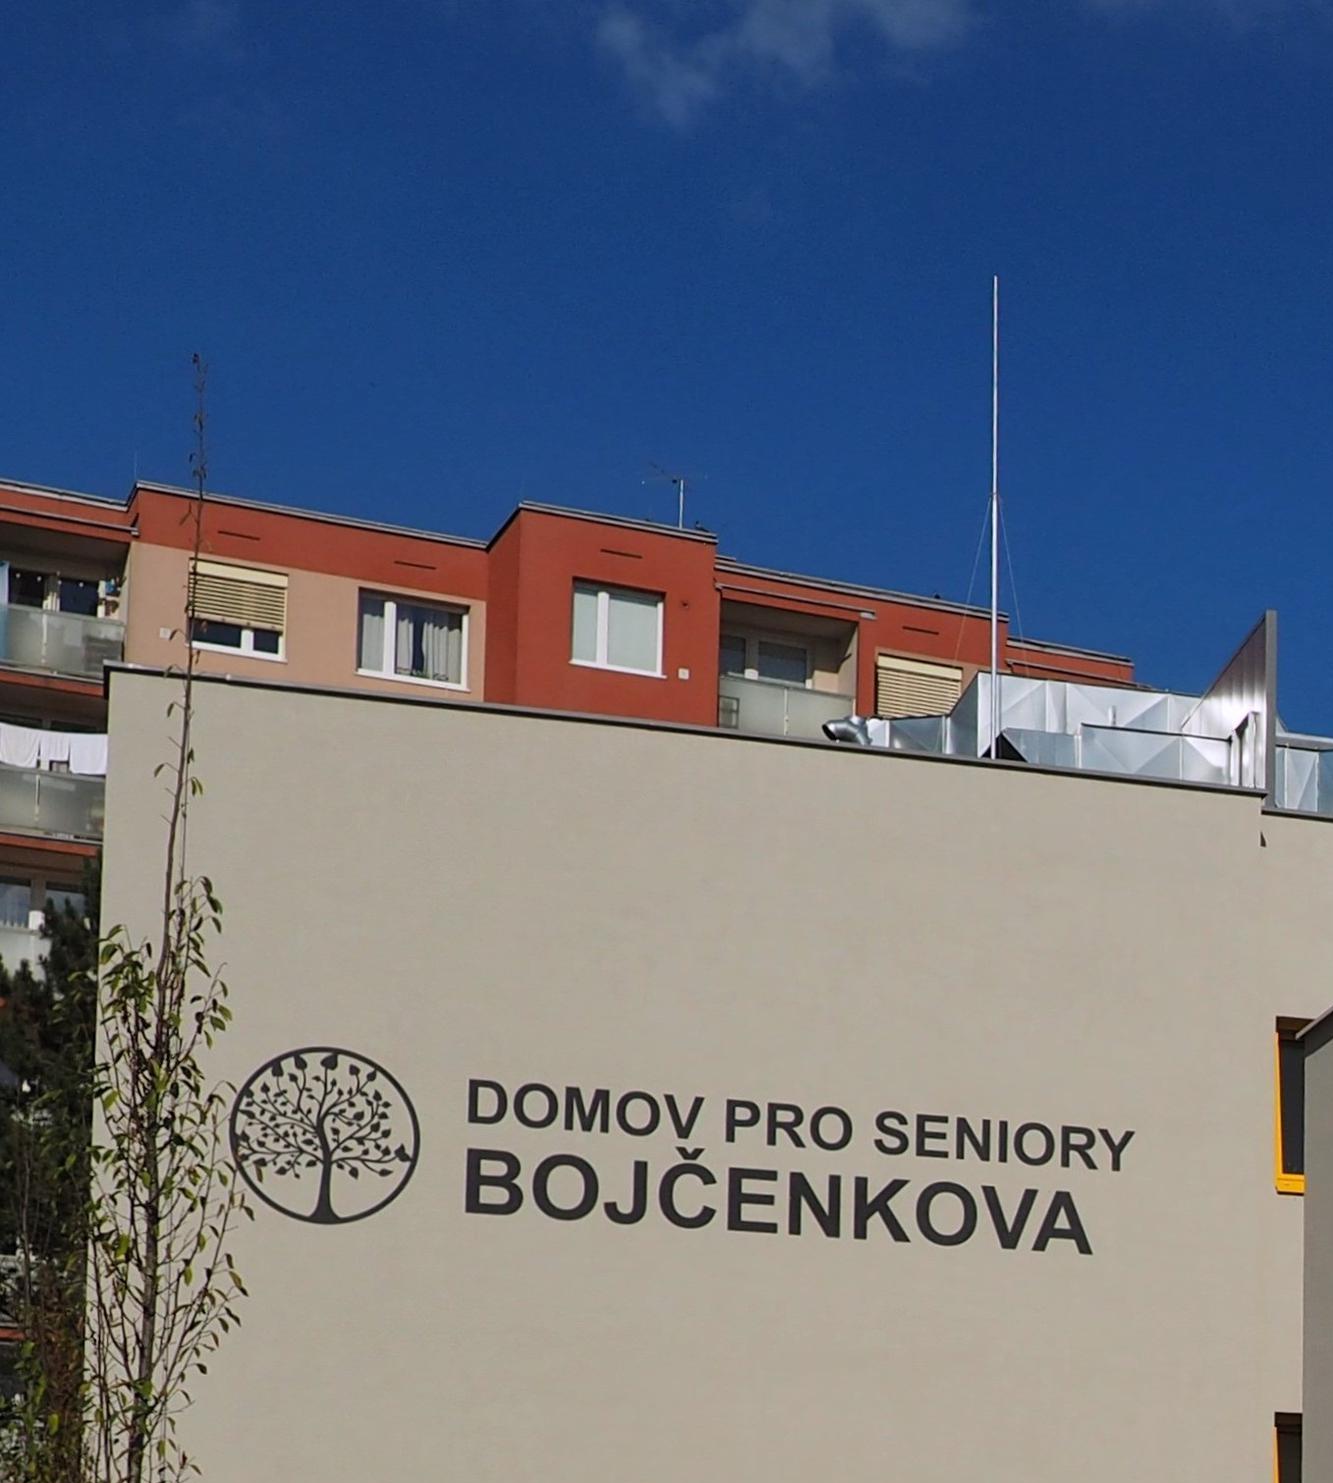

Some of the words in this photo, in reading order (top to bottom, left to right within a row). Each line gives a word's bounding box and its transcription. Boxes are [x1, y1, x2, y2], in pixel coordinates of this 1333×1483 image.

[466, 1078, 705, 1140] DOMOV
[725, 1098, 853, 1152] PRO
[874, 1110, 1136, 1172] SENIORY
[465, 1146, 1093, 1256] BOJČENKOVA
